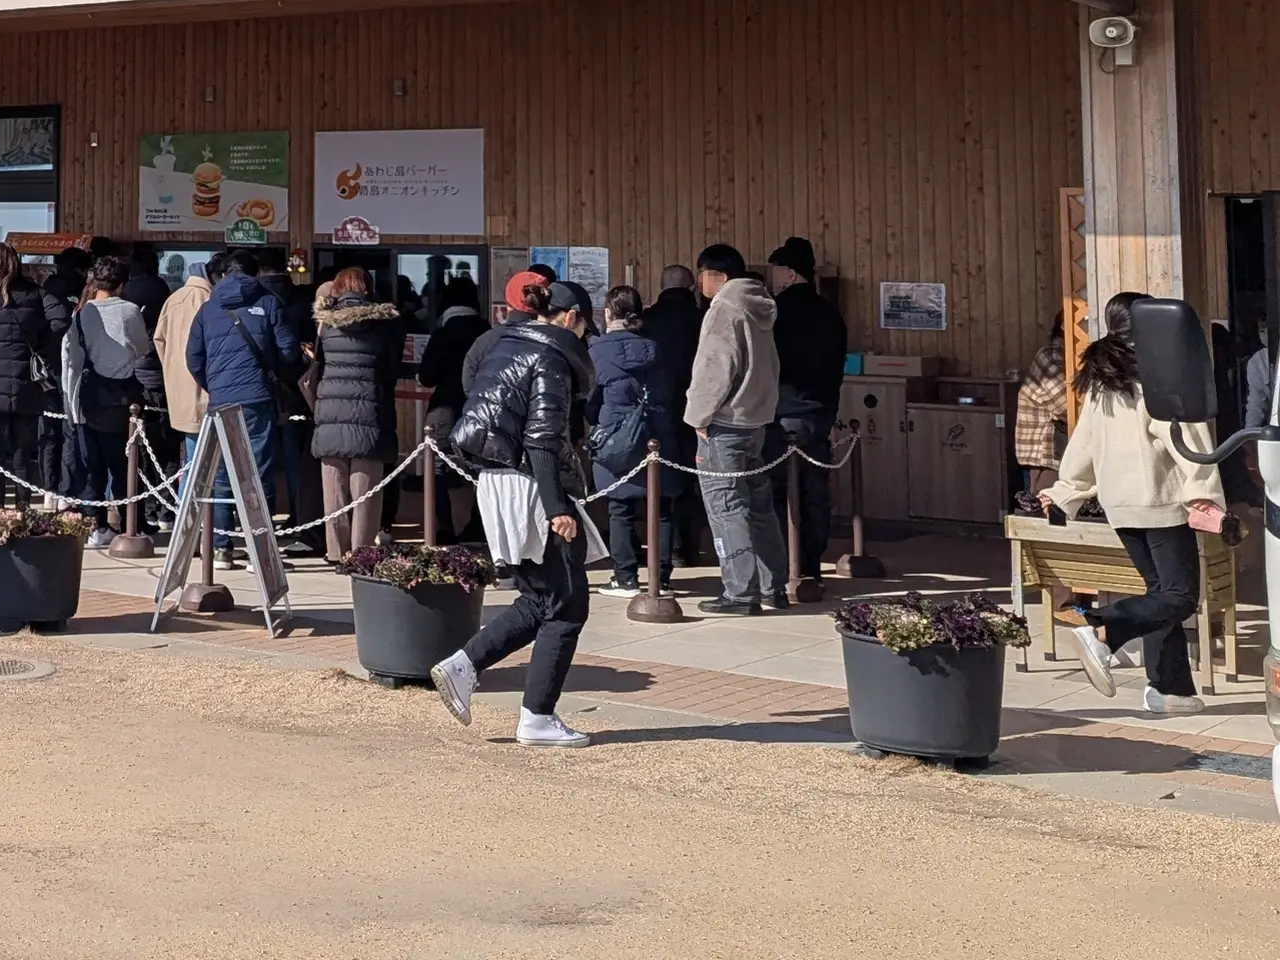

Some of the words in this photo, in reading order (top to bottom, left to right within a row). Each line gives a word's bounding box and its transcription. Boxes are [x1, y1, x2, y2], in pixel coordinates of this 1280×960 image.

[364, 164, 447, 177] あわじ島バーガー
[353, 184, 460, 197] 路島オニオンキッチン
